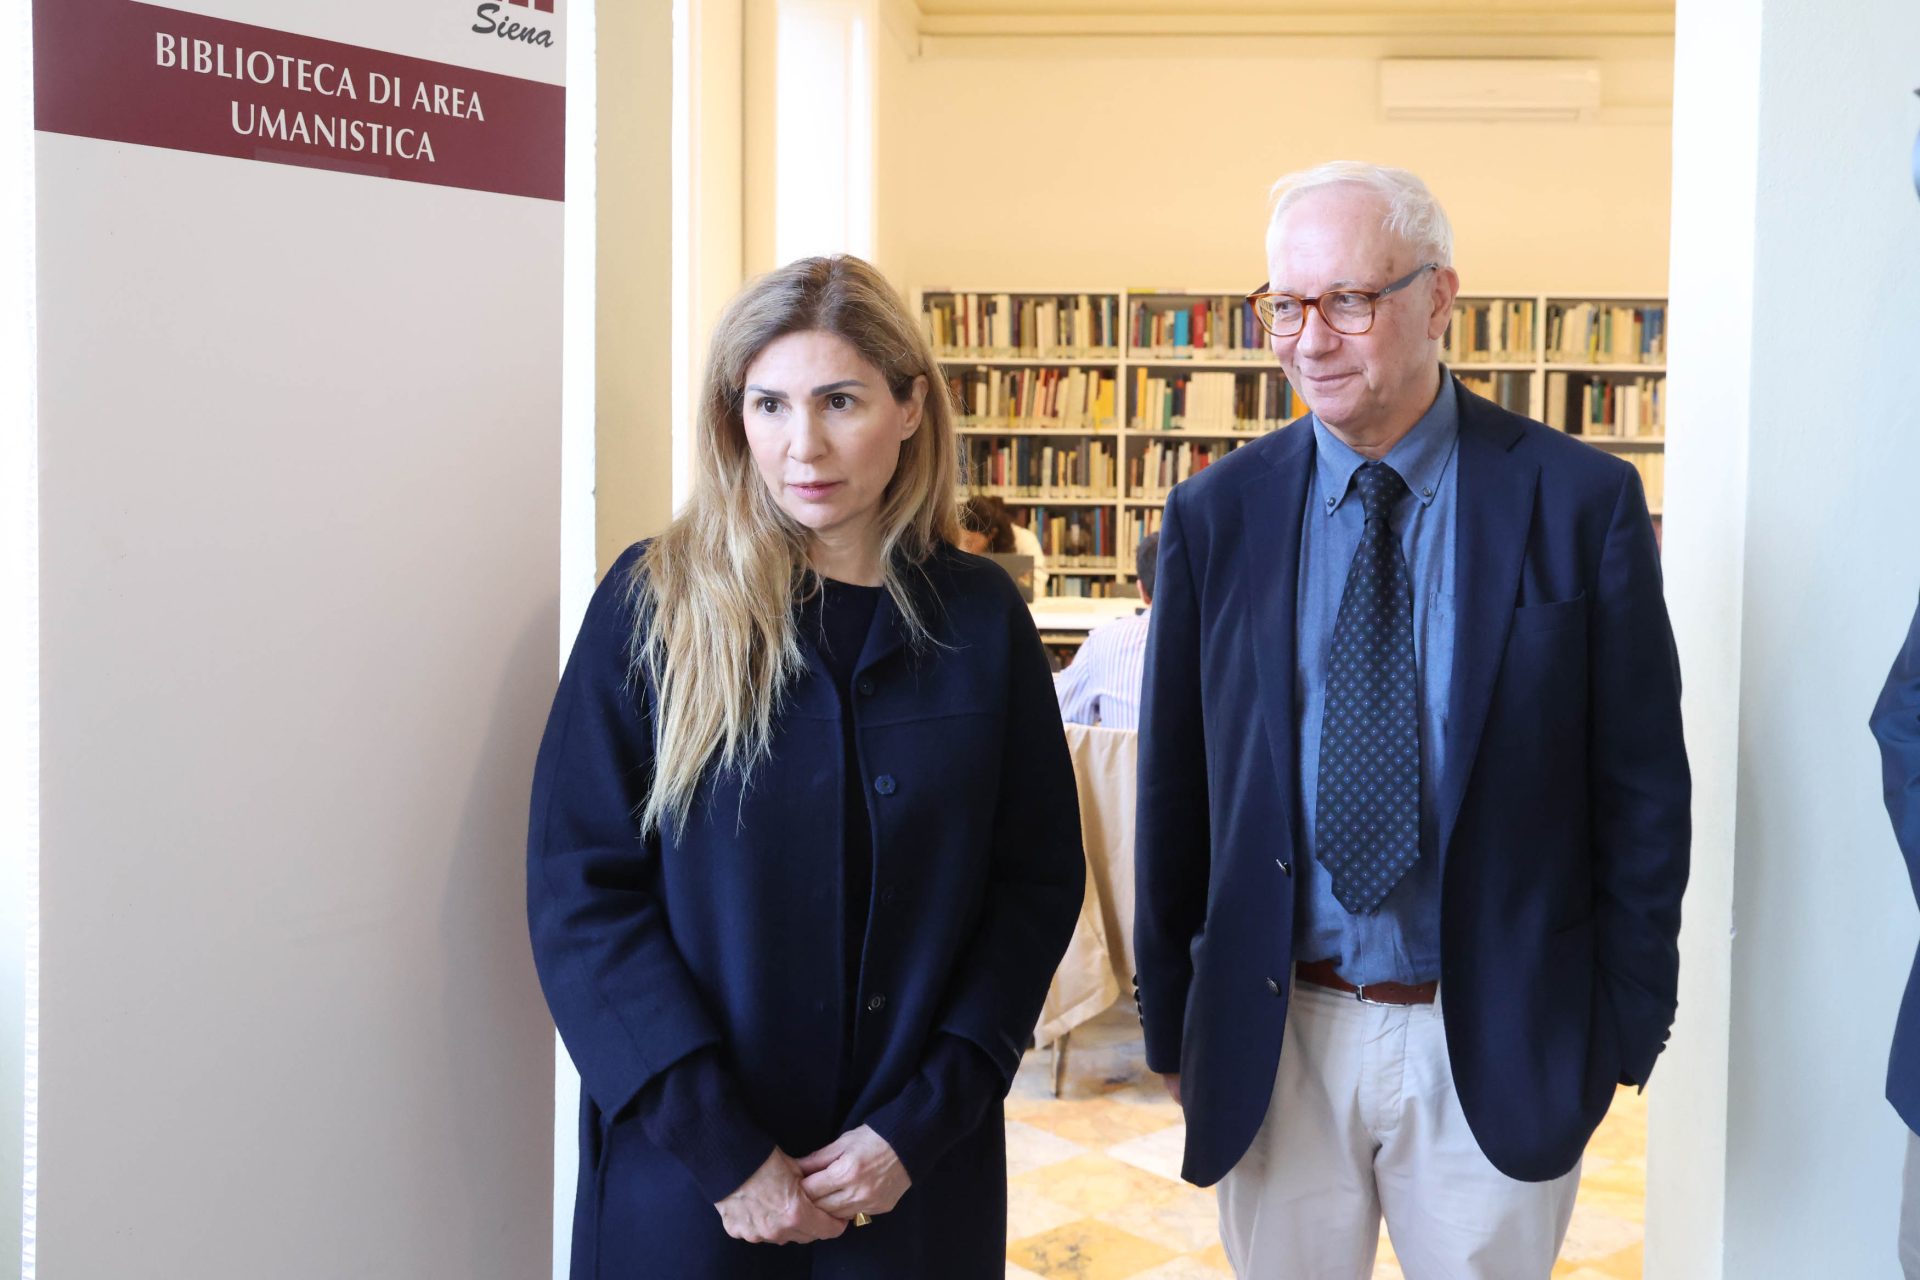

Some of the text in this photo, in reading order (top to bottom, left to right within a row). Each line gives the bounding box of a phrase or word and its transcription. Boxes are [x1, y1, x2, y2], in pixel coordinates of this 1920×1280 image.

[471, 2, 554, 48] Siena
[154, 31, 485, 122] BIBLIOTECA DI AREA
[231, 100, 436, 163] UMANISTICA
